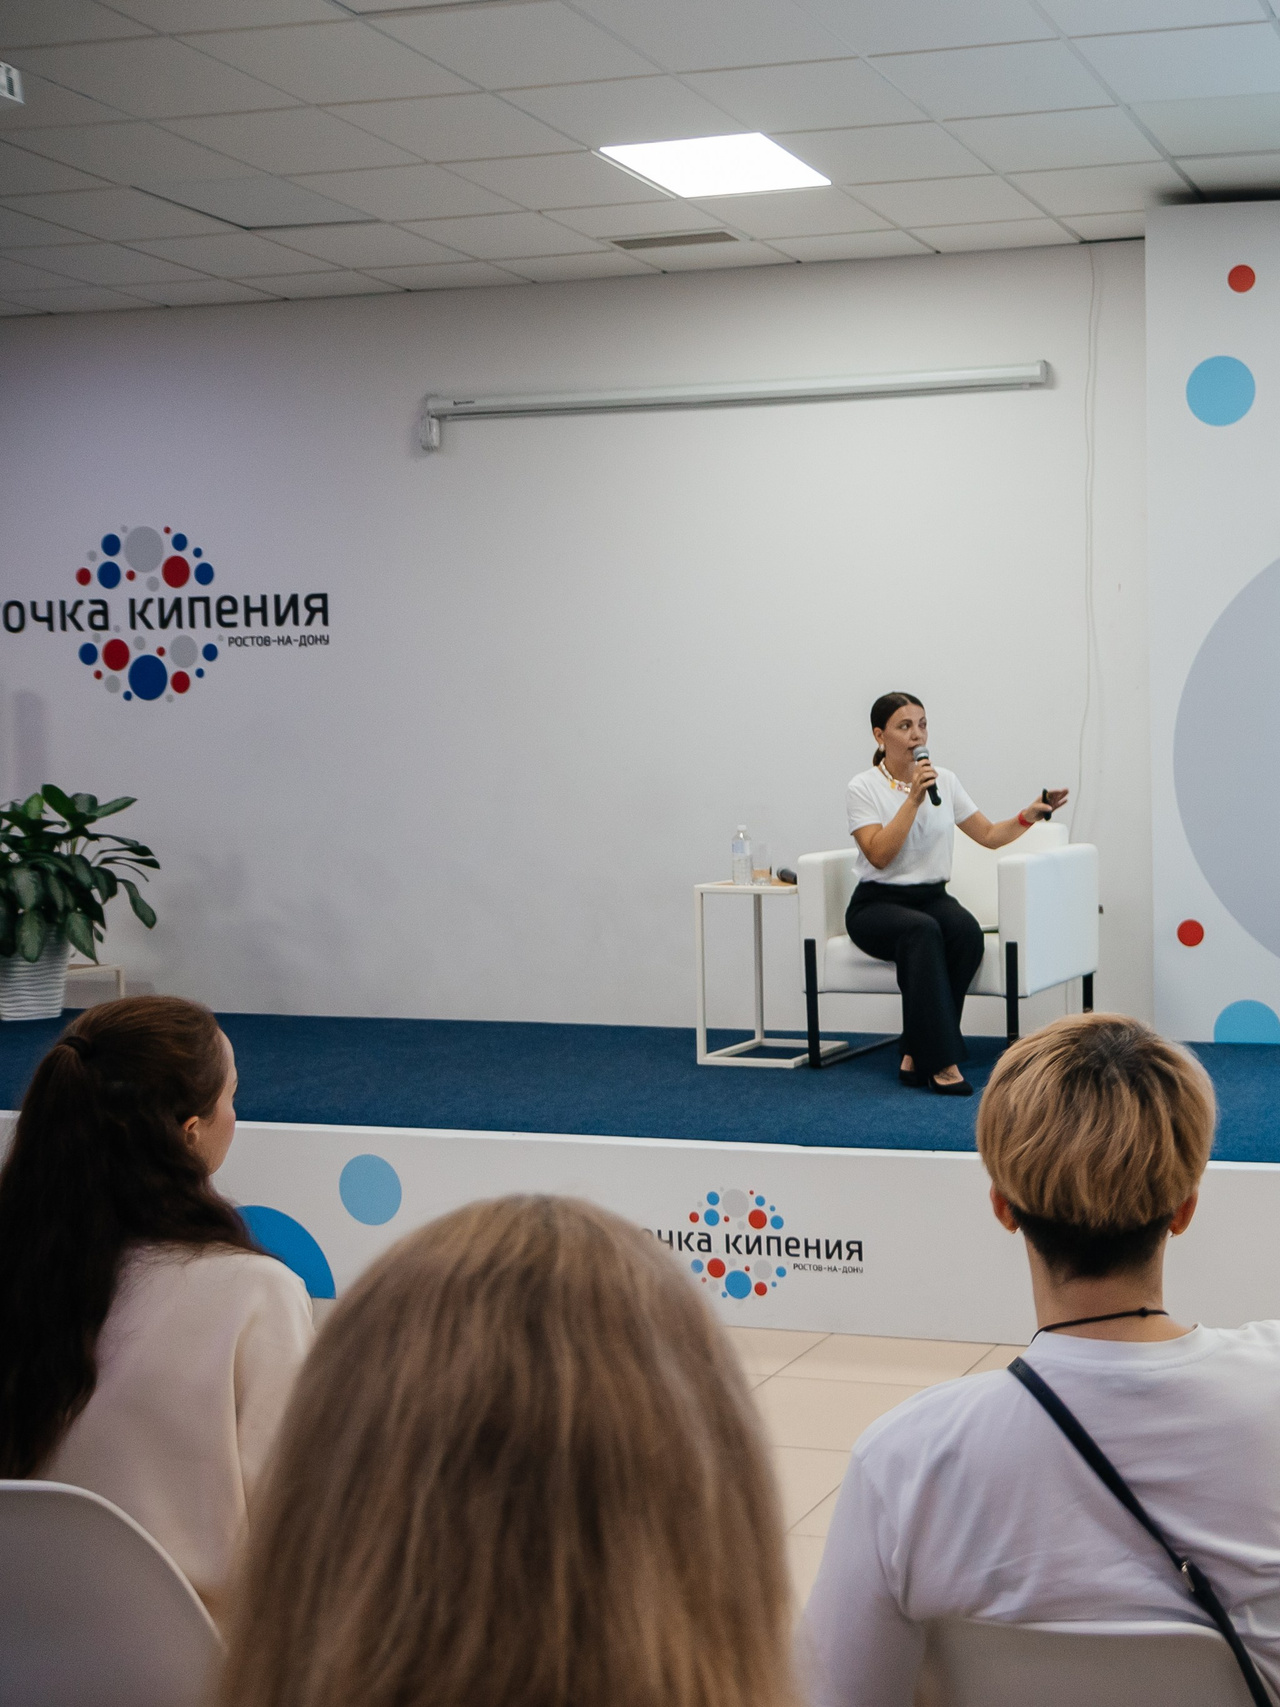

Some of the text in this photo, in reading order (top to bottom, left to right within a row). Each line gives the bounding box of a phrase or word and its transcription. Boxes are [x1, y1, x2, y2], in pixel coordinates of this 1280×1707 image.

[1, 592, 330, 633] очка кипения
[228, 633, 330, 648] РОСТОВ-НА-ДОНУ
[724, 1233, 864, 1263] кипения
[792, 1262, 865, 1275] РОСТОВ-НА-ДОНУ
